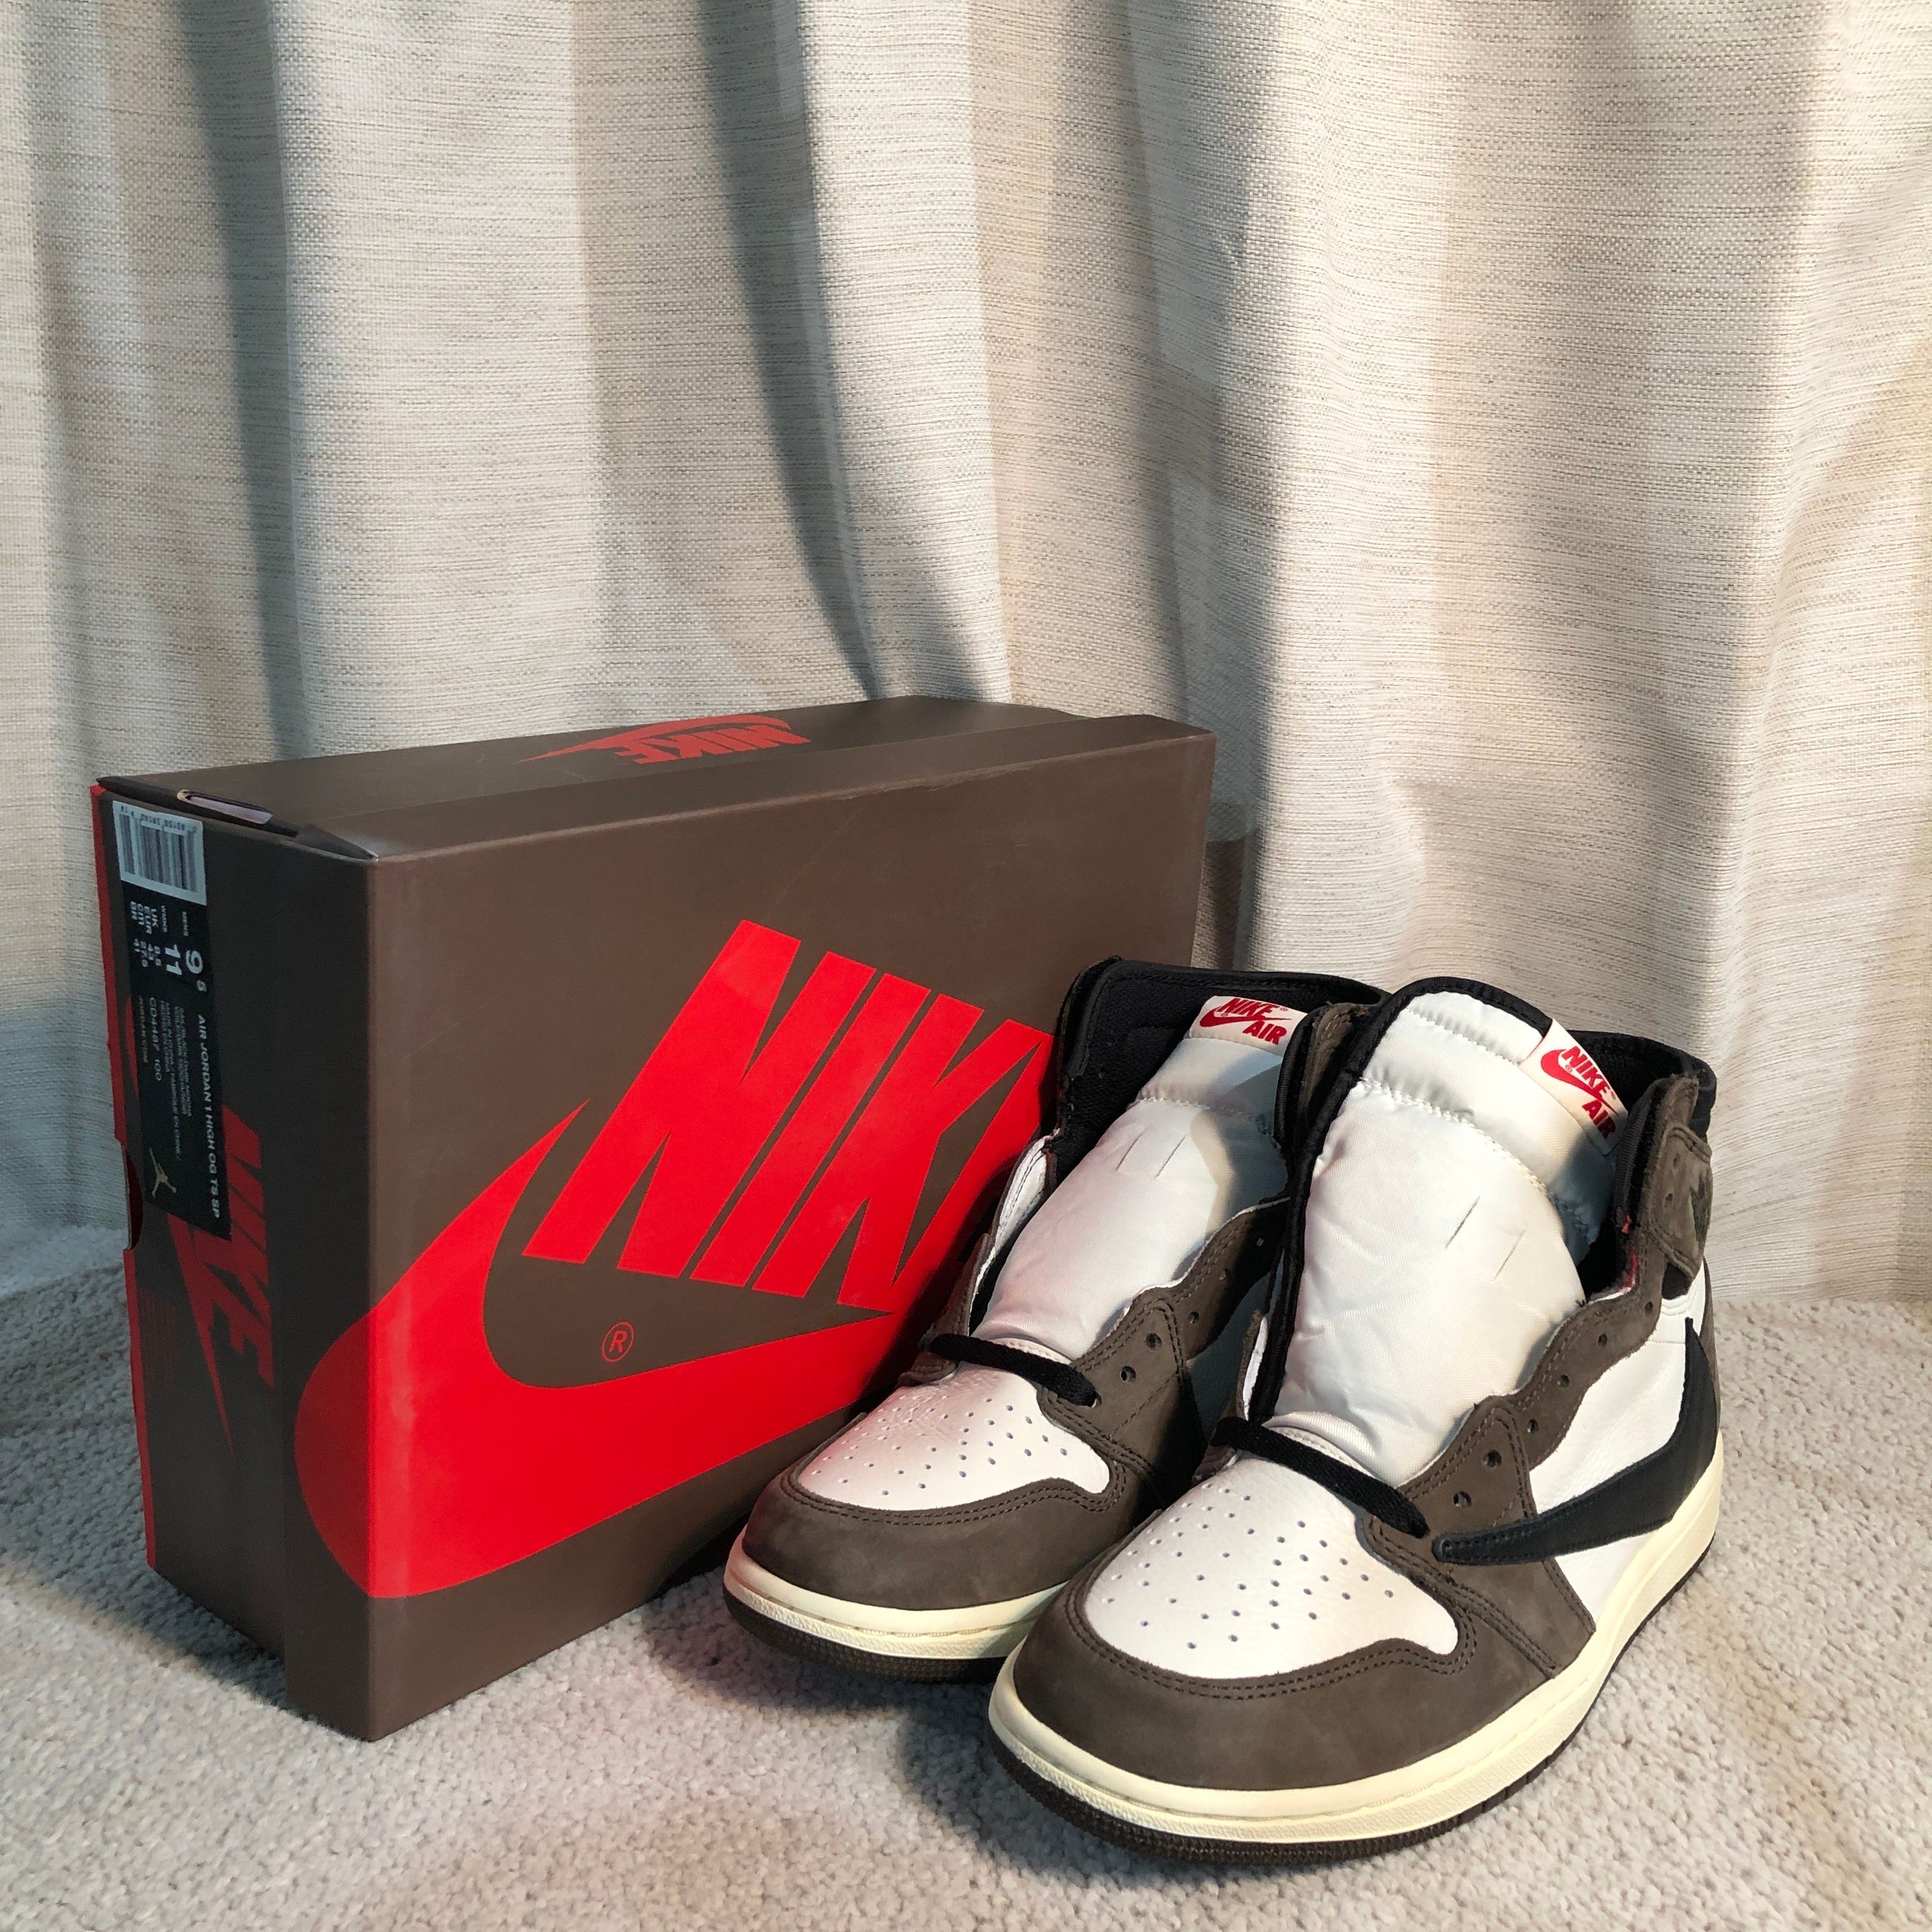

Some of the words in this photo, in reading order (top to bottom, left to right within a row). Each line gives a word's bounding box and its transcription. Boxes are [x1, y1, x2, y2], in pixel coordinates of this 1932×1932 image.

[614, 725, 811, 764] NIKE
[151, 908, 158, 928] UK
[164, 944, 183, 976] 11
[185, 949, 203, 974] 9
[1216, 998, 1280, 1018] NIKE
[198, 1014, 208, 1039] AIR
[1242, 1020, 1287, 1045] AIR
[200, 1042, 212, 1103] JORDAN
[1561, 1045, 1611, 1094] NIKE
[206, 1114, 216, 1150] HIGH
[1581, 1099, 1616, 1140] AIR
[208, 1153, 217, 1174] OG
[210, 1178, 219, 1197] TS
[211, 1198, 220, 1219] SP
